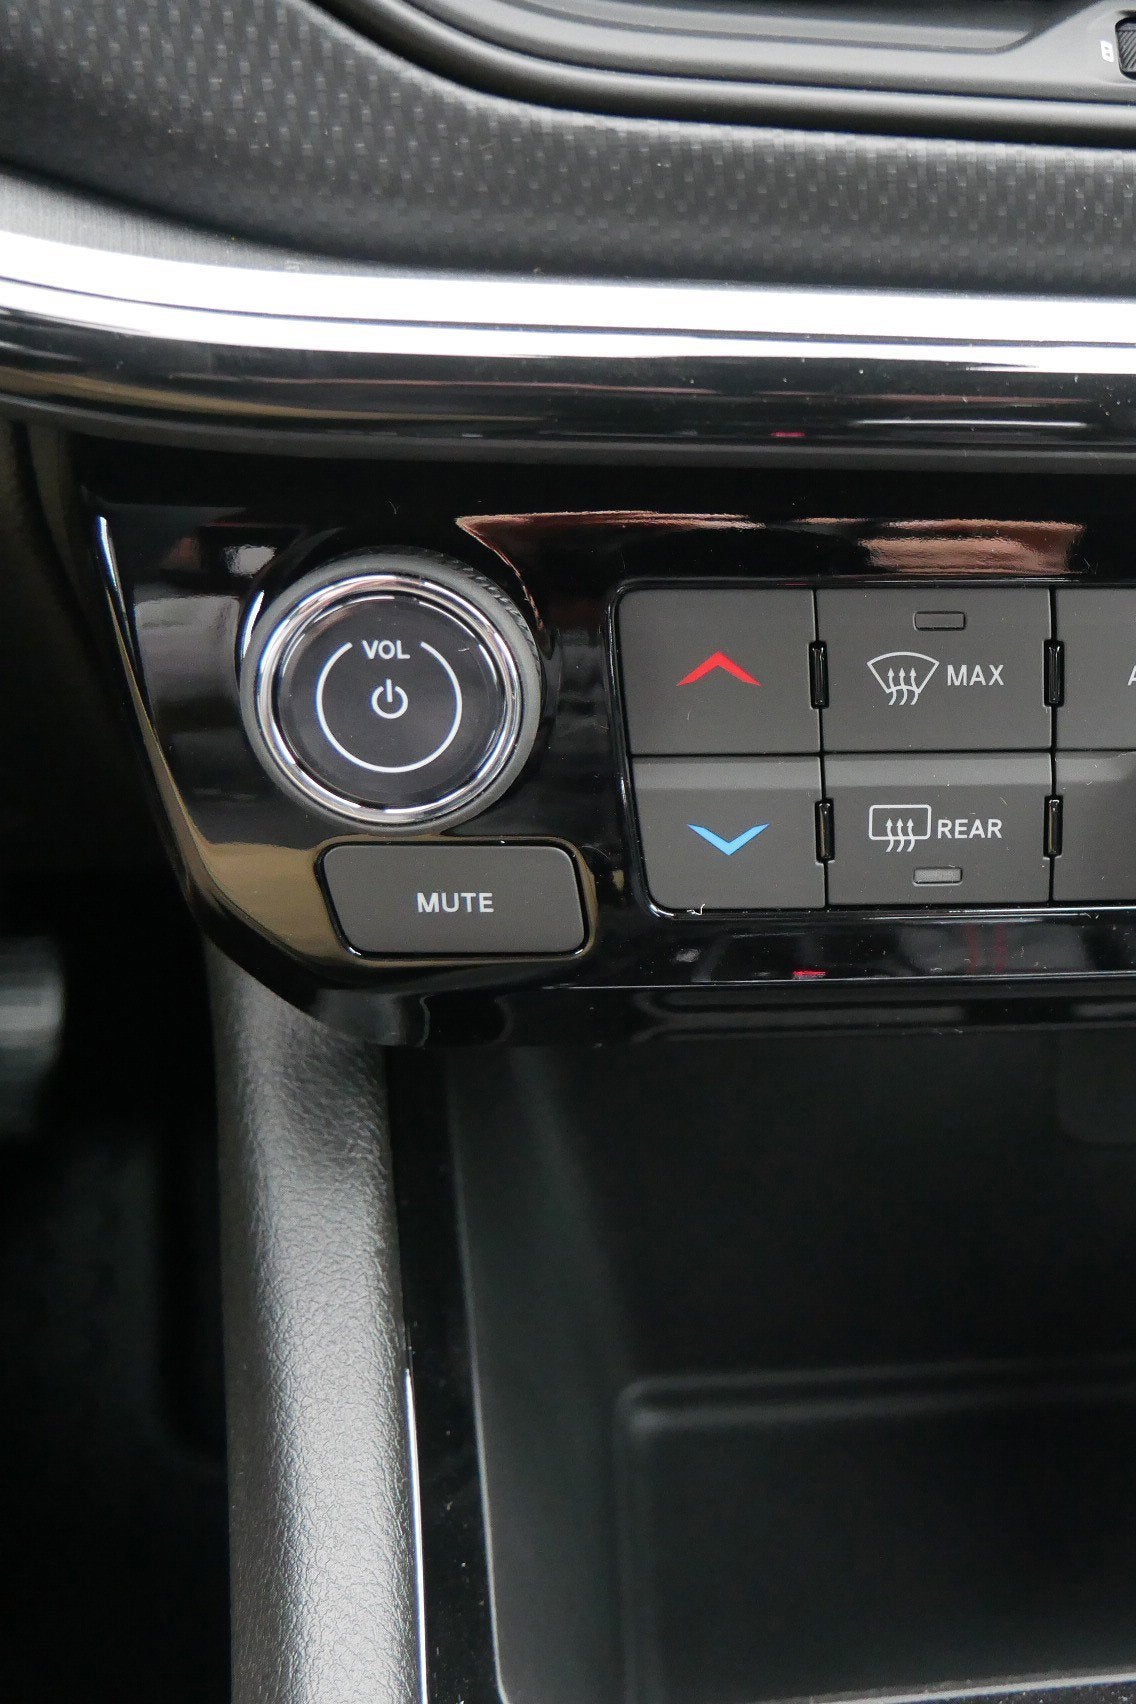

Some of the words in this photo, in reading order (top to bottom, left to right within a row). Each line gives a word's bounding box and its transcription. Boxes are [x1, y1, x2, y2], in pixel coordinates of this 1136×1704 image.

[361, 639, 411, 660] VOL
[946, 664, 1004, 687] MAX
[937, 818, 1003, 840] REAR
[416, 892, 495, 913] MUTE
